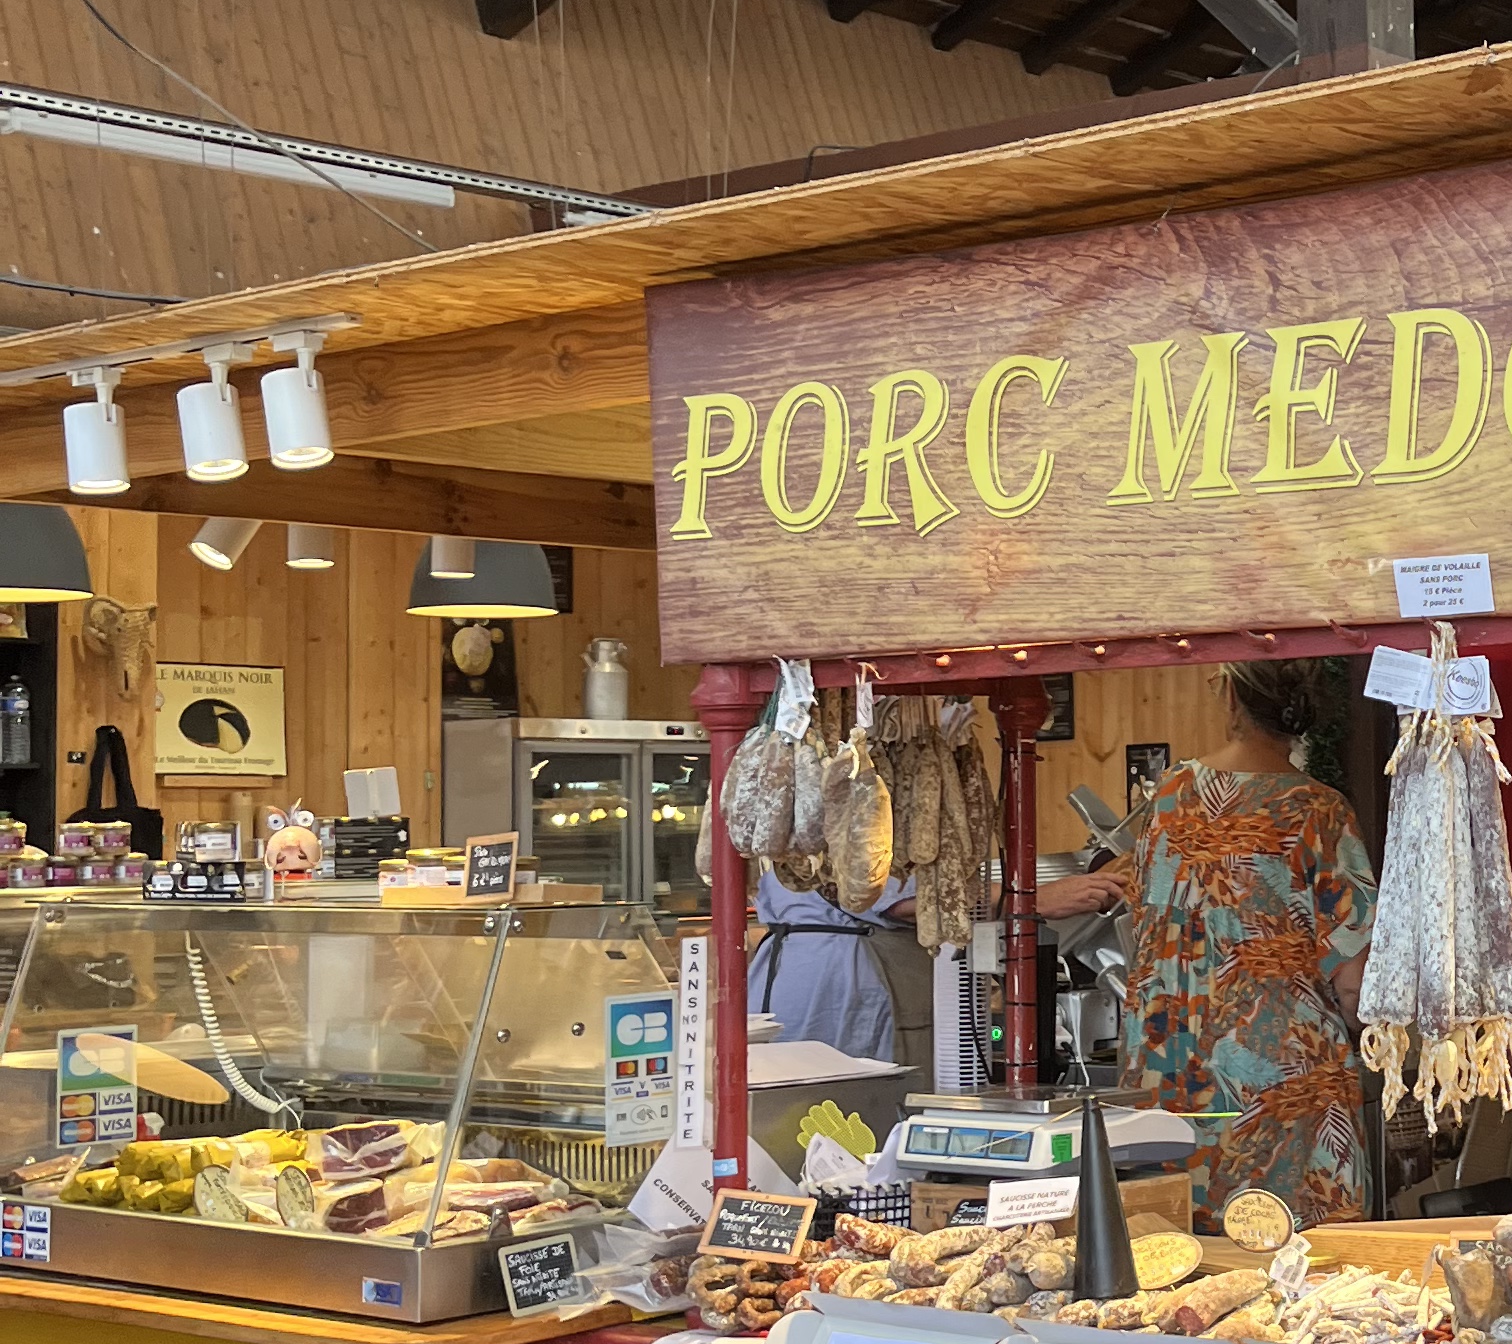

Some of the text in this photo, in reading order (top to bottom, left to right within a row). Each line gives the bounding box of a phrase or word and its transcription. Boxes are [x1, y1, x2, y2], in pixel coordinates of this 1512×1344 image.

[670, 354, 1070, 540] PORC
[1400, 564, 1430, 574] MAIGRE
[1444, 561, 1481, 571] VOLAILLE
[1419, 574, 1464, 584] SANS PORC
[1422, 599, 1428, 607] 2
[156, 668, 273, 684] E MARQUIS NOIR
[682, 1031, 697, 1140] NITRITE
[102, 1092, 133, 1106] VISA
[102, 1117, 133, 1132] VISA
[653, 1178, 707, 1225] CONSERVAT
[1000, 1189, 1070, 1204] SAUCISSE NATURE
[28, 1207, 48, 1223] VISA
[27, 1235, 48, 1251] VISA
[507, 1243, 566, 1268] SAUCISSE DE
